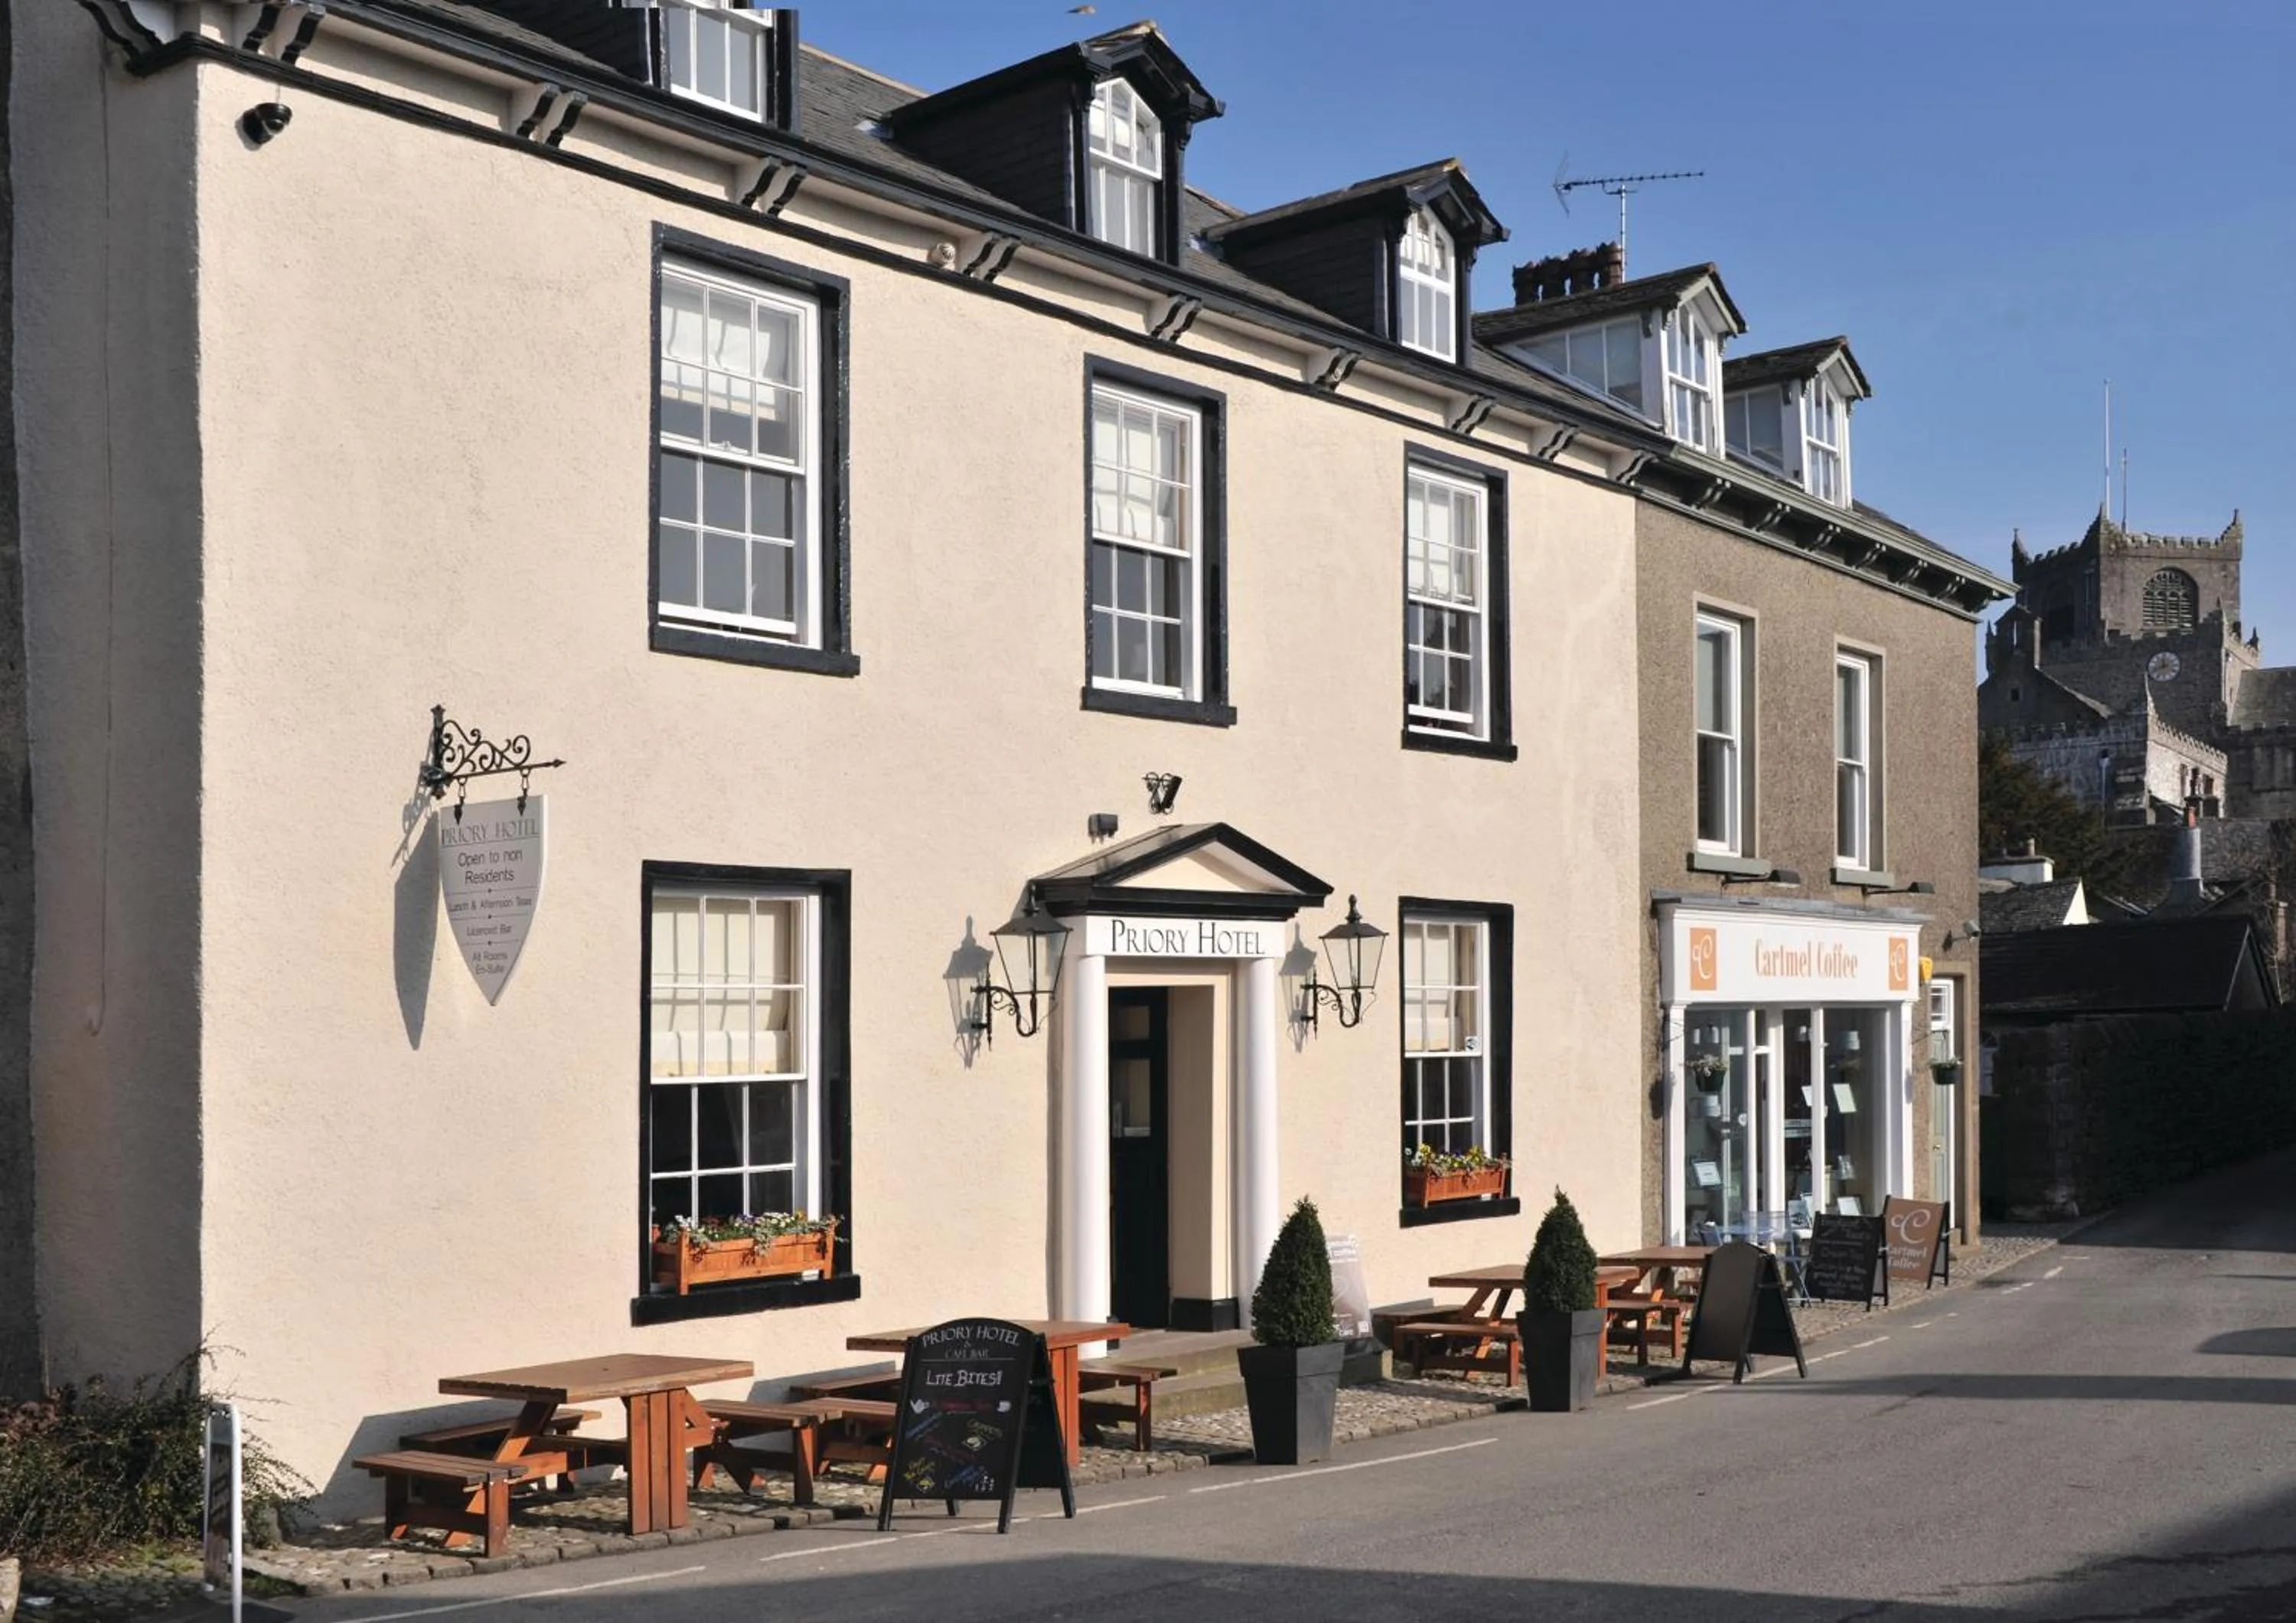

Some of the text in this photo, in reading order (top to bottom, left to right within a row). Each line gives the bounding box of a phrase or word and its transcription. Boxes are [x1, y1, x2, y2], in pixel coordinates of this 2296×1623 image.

[442, 818, 539, 844] PRIORY HOTEL
[458, 850, 523, 867] Open to non
[465, 868, 514, 884] Residents
[1112, 919, 1265, 955] PRIORY HOTEL
[1755, 938, 1858, 978] Cartmel Coffee
[922, 1326, 1020, 1347] PRIORY HOTEL
